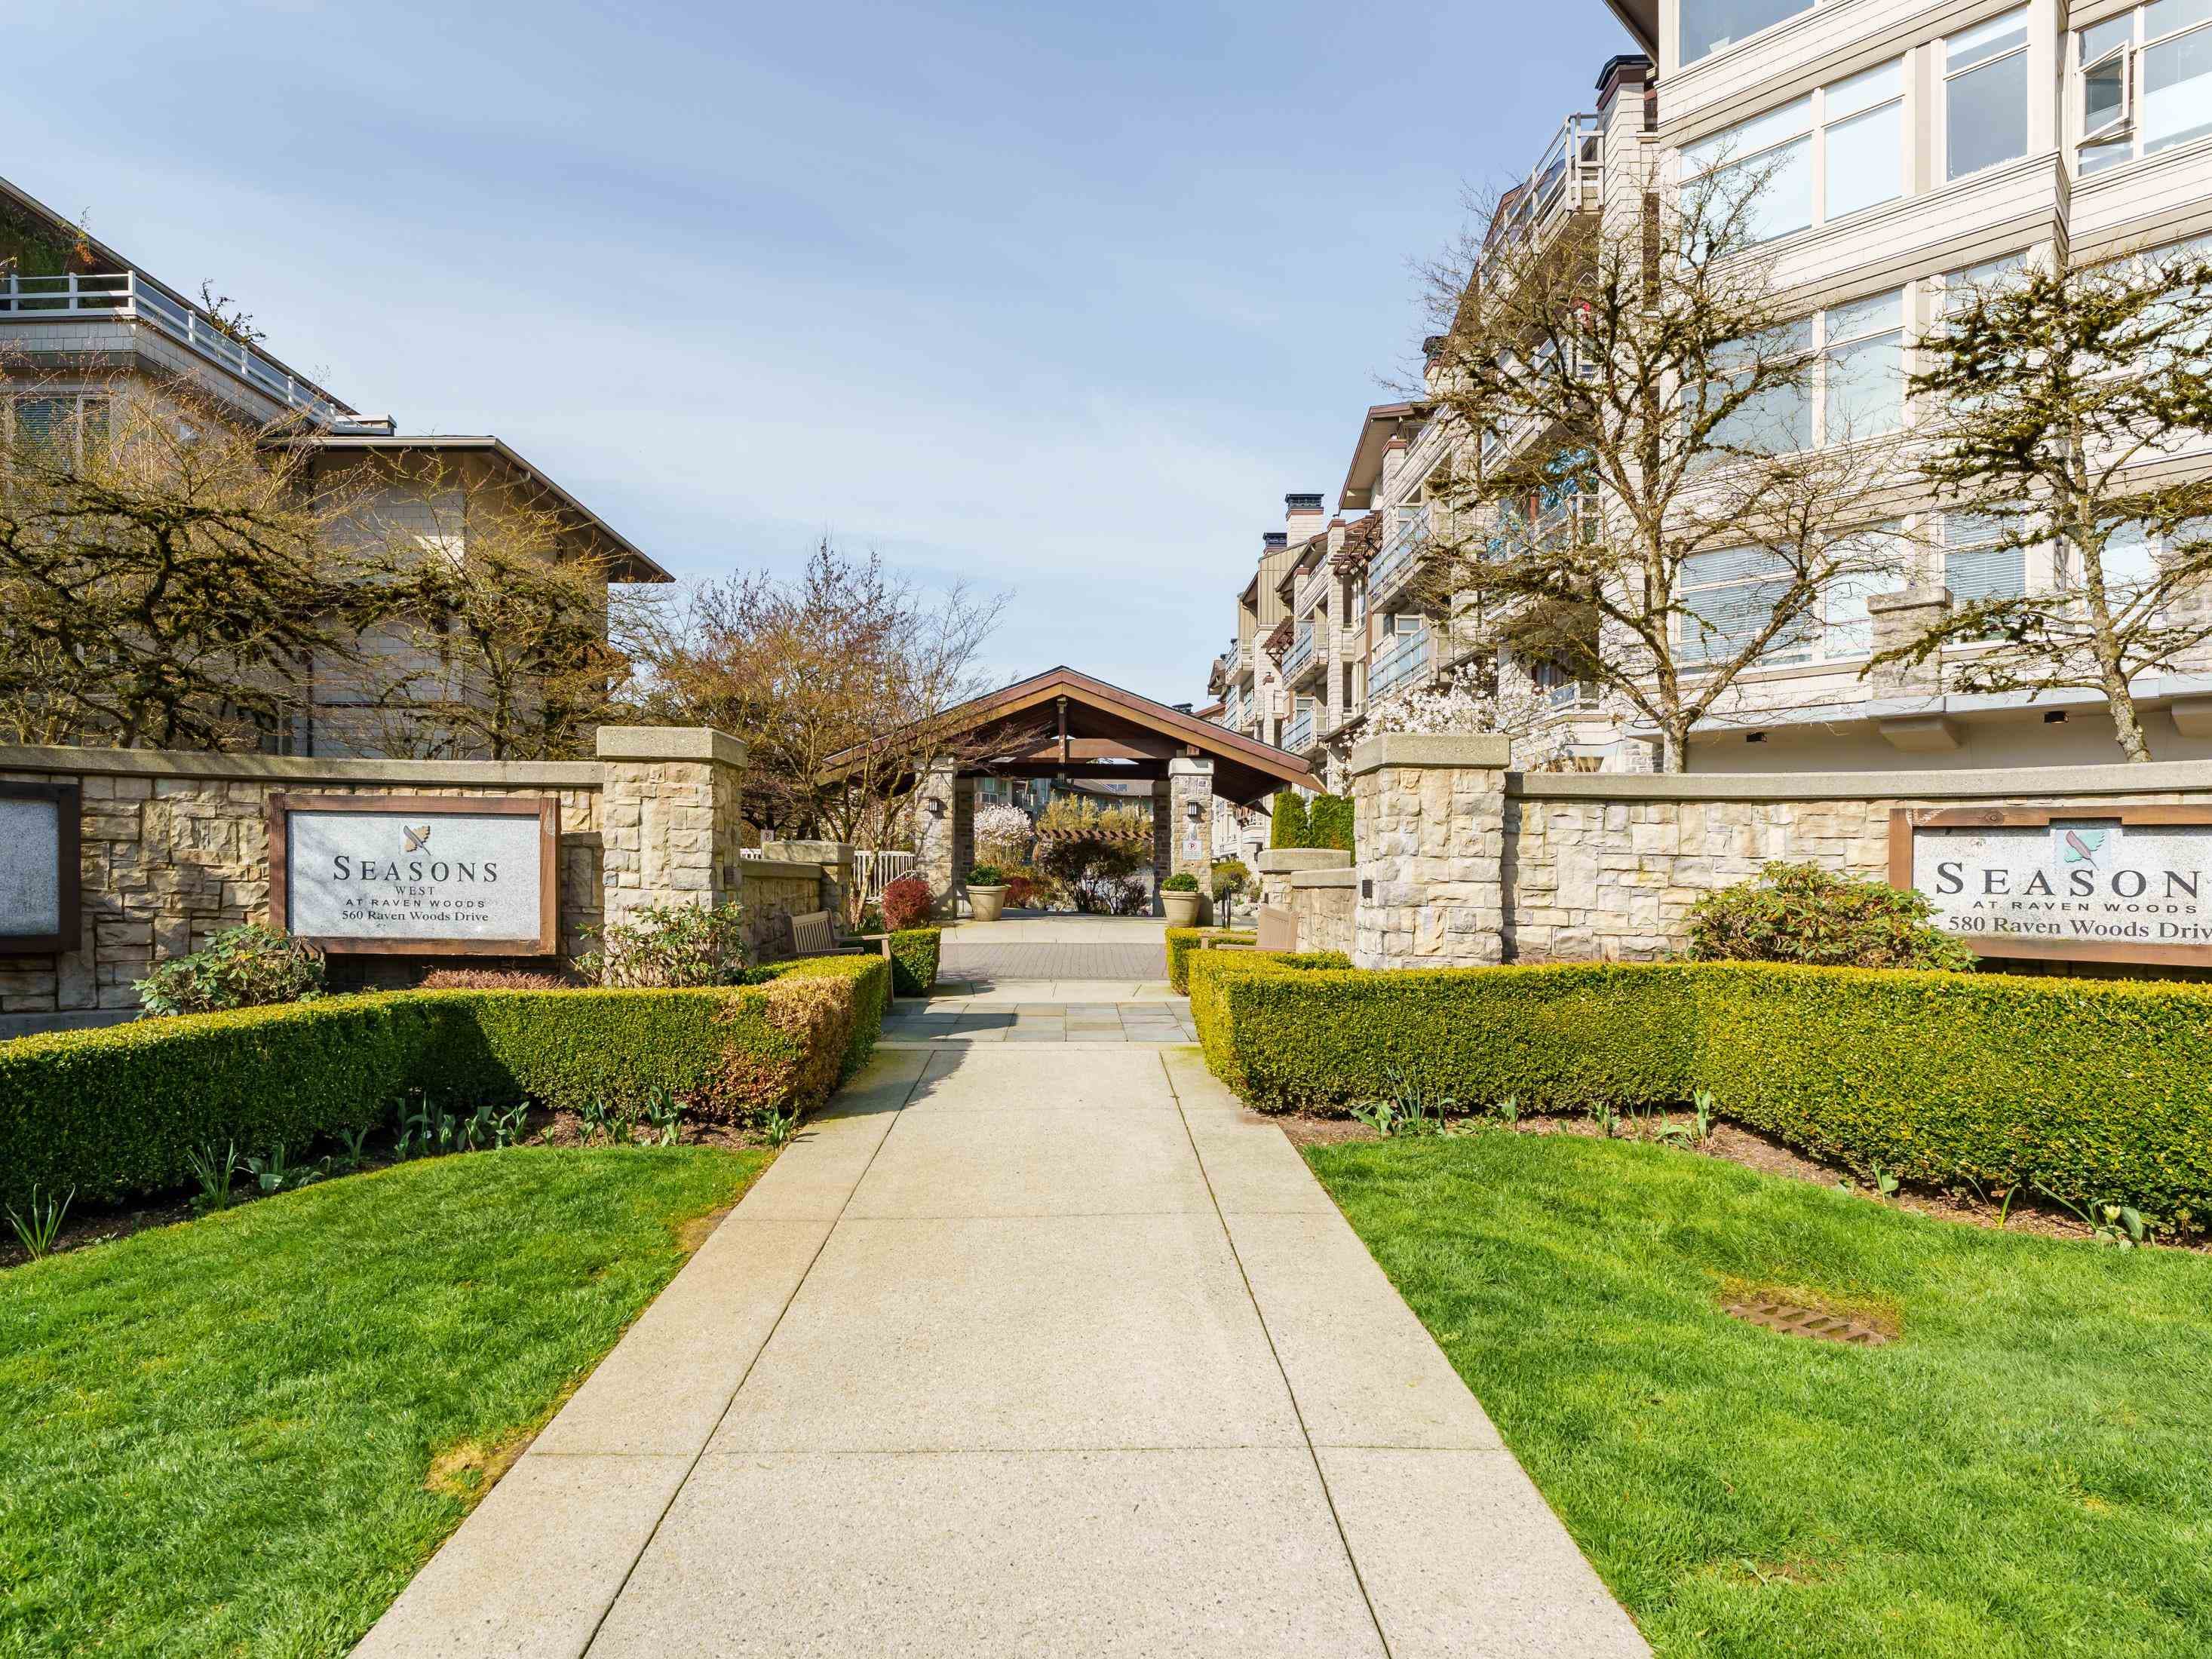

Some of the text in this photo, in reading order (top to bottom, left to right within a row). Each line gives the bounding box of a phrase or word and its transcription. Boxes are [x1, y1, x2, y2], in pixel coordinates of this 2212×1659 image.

[333, 855, 498, 882] SEASONS
[396, 886, 435, 895] WEST
[1973, 900, 2197, 914] AT RAVEN WOODS
[342, 910, 489, 921] 560 Raven Woods Drive
[1948, 916, 1986, 932] 580
[1993, 917, 2061, 934] Raven
[2069, 919, 2149, 937] Woods
